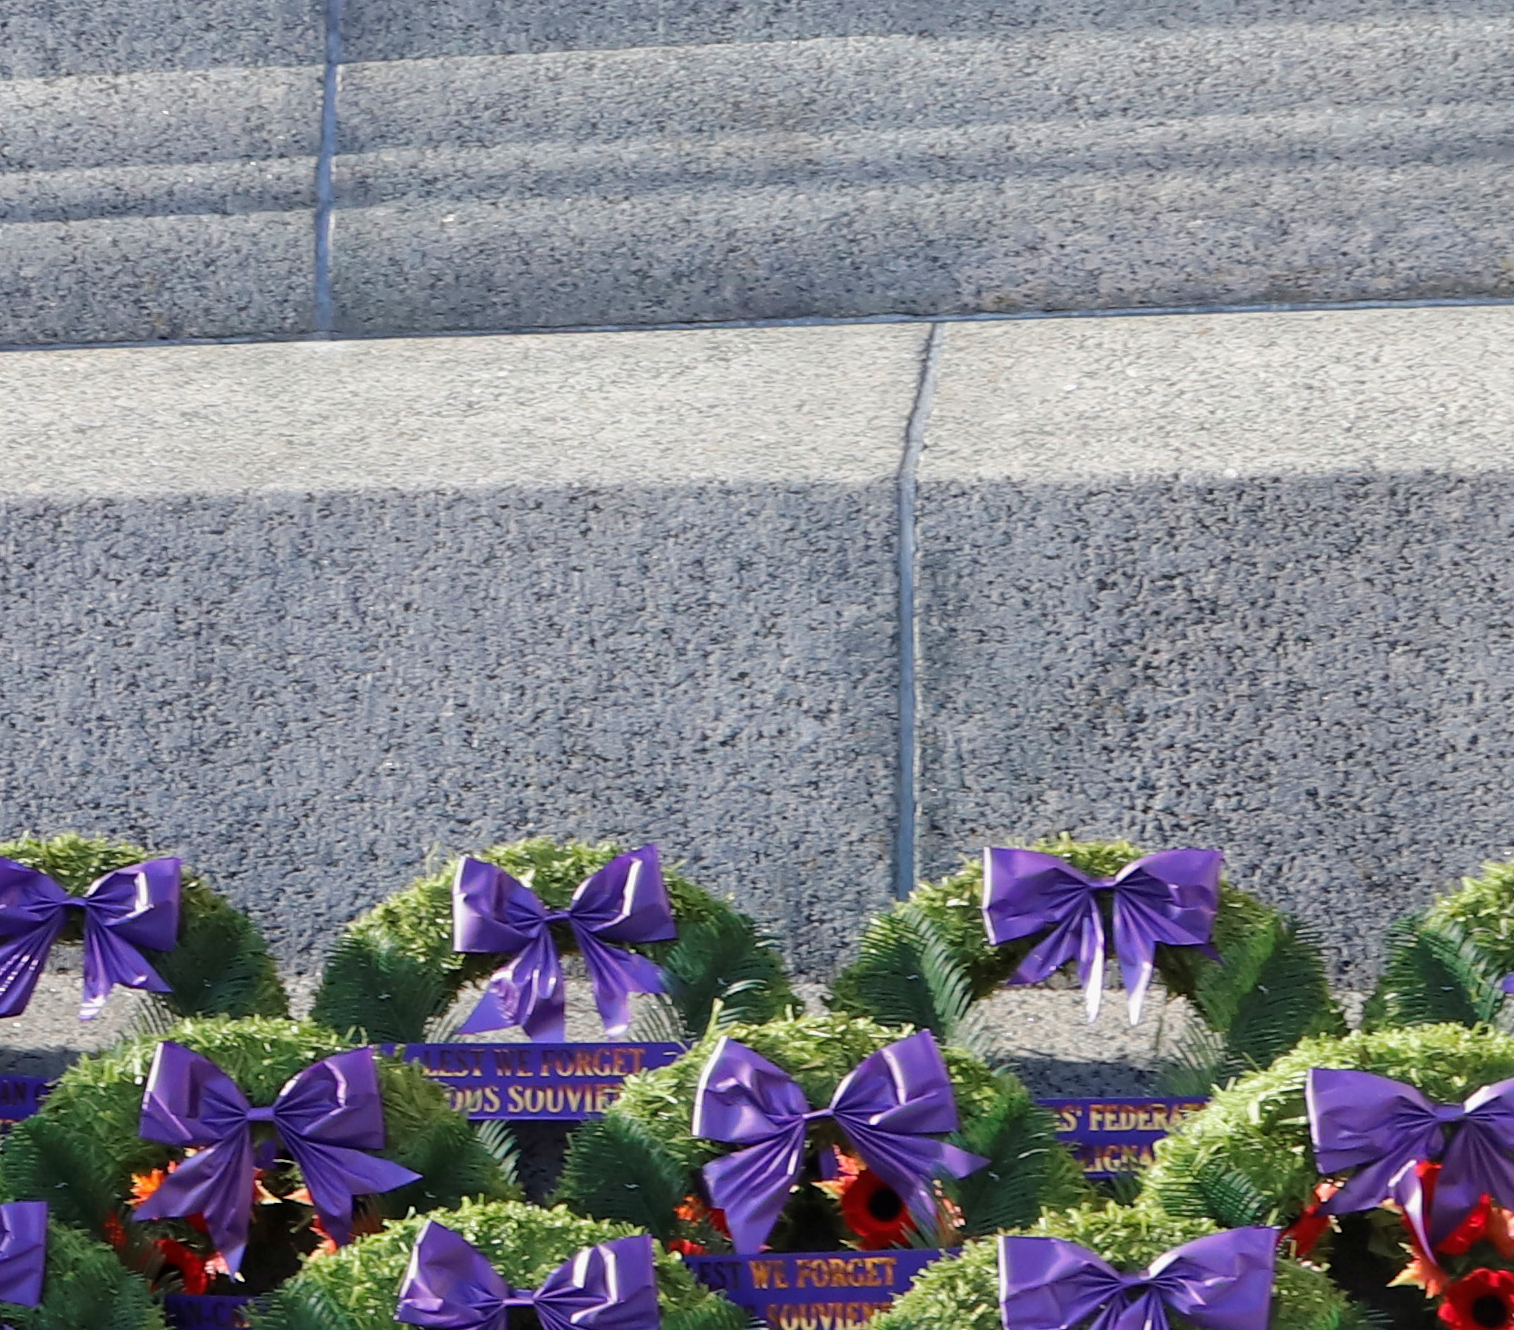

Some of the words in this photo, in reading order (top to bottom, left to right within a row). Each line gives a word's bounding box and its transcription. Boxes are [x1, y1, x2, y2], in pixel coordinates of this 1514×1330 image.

[422, 1048, 483, 1077] LEST
[494, 1049, 534, 1077] WE
[539, 1048, 646, 1077] FORGET
[748, 1259, 789, 1289] WE
[796, 1257, 897, 1289] FORGET
